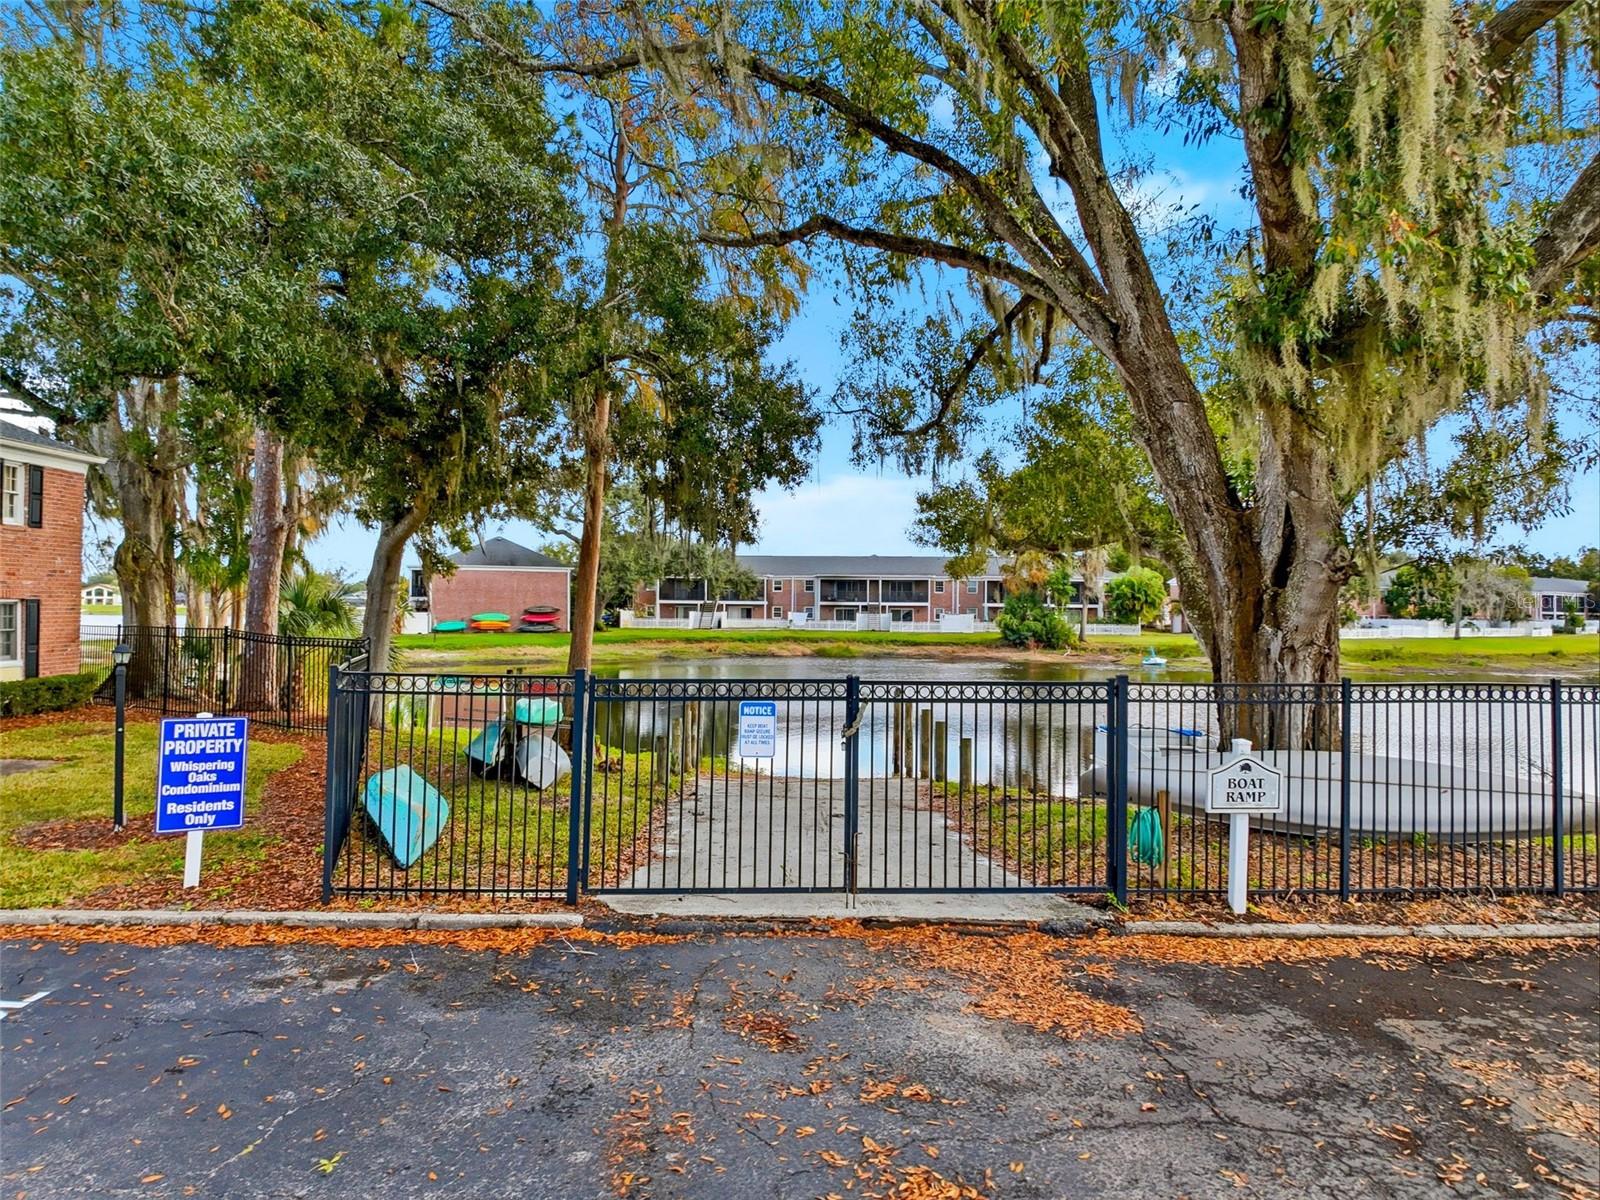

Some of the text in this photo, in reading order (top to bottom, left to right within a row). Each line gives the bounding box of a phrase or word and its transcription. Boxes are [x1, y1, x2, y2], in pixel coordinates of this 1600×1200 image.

[743, 706, 773, 715] NOTICE
[174, 722, 235, 738] PRIVATE
[164, 738, 243, 755] PROPERTY
[170, 760, 235, 773] Whispering
[187, 772, 217, 783] Oaks
[1228, 778, 1265, 789] BOAT
[162, 782, 241, 796] Condominium
[1226, 791, 1266, 802] RAMP
[167, 800, 235, 814] Residents
[185, 814, 216, 826] Only
